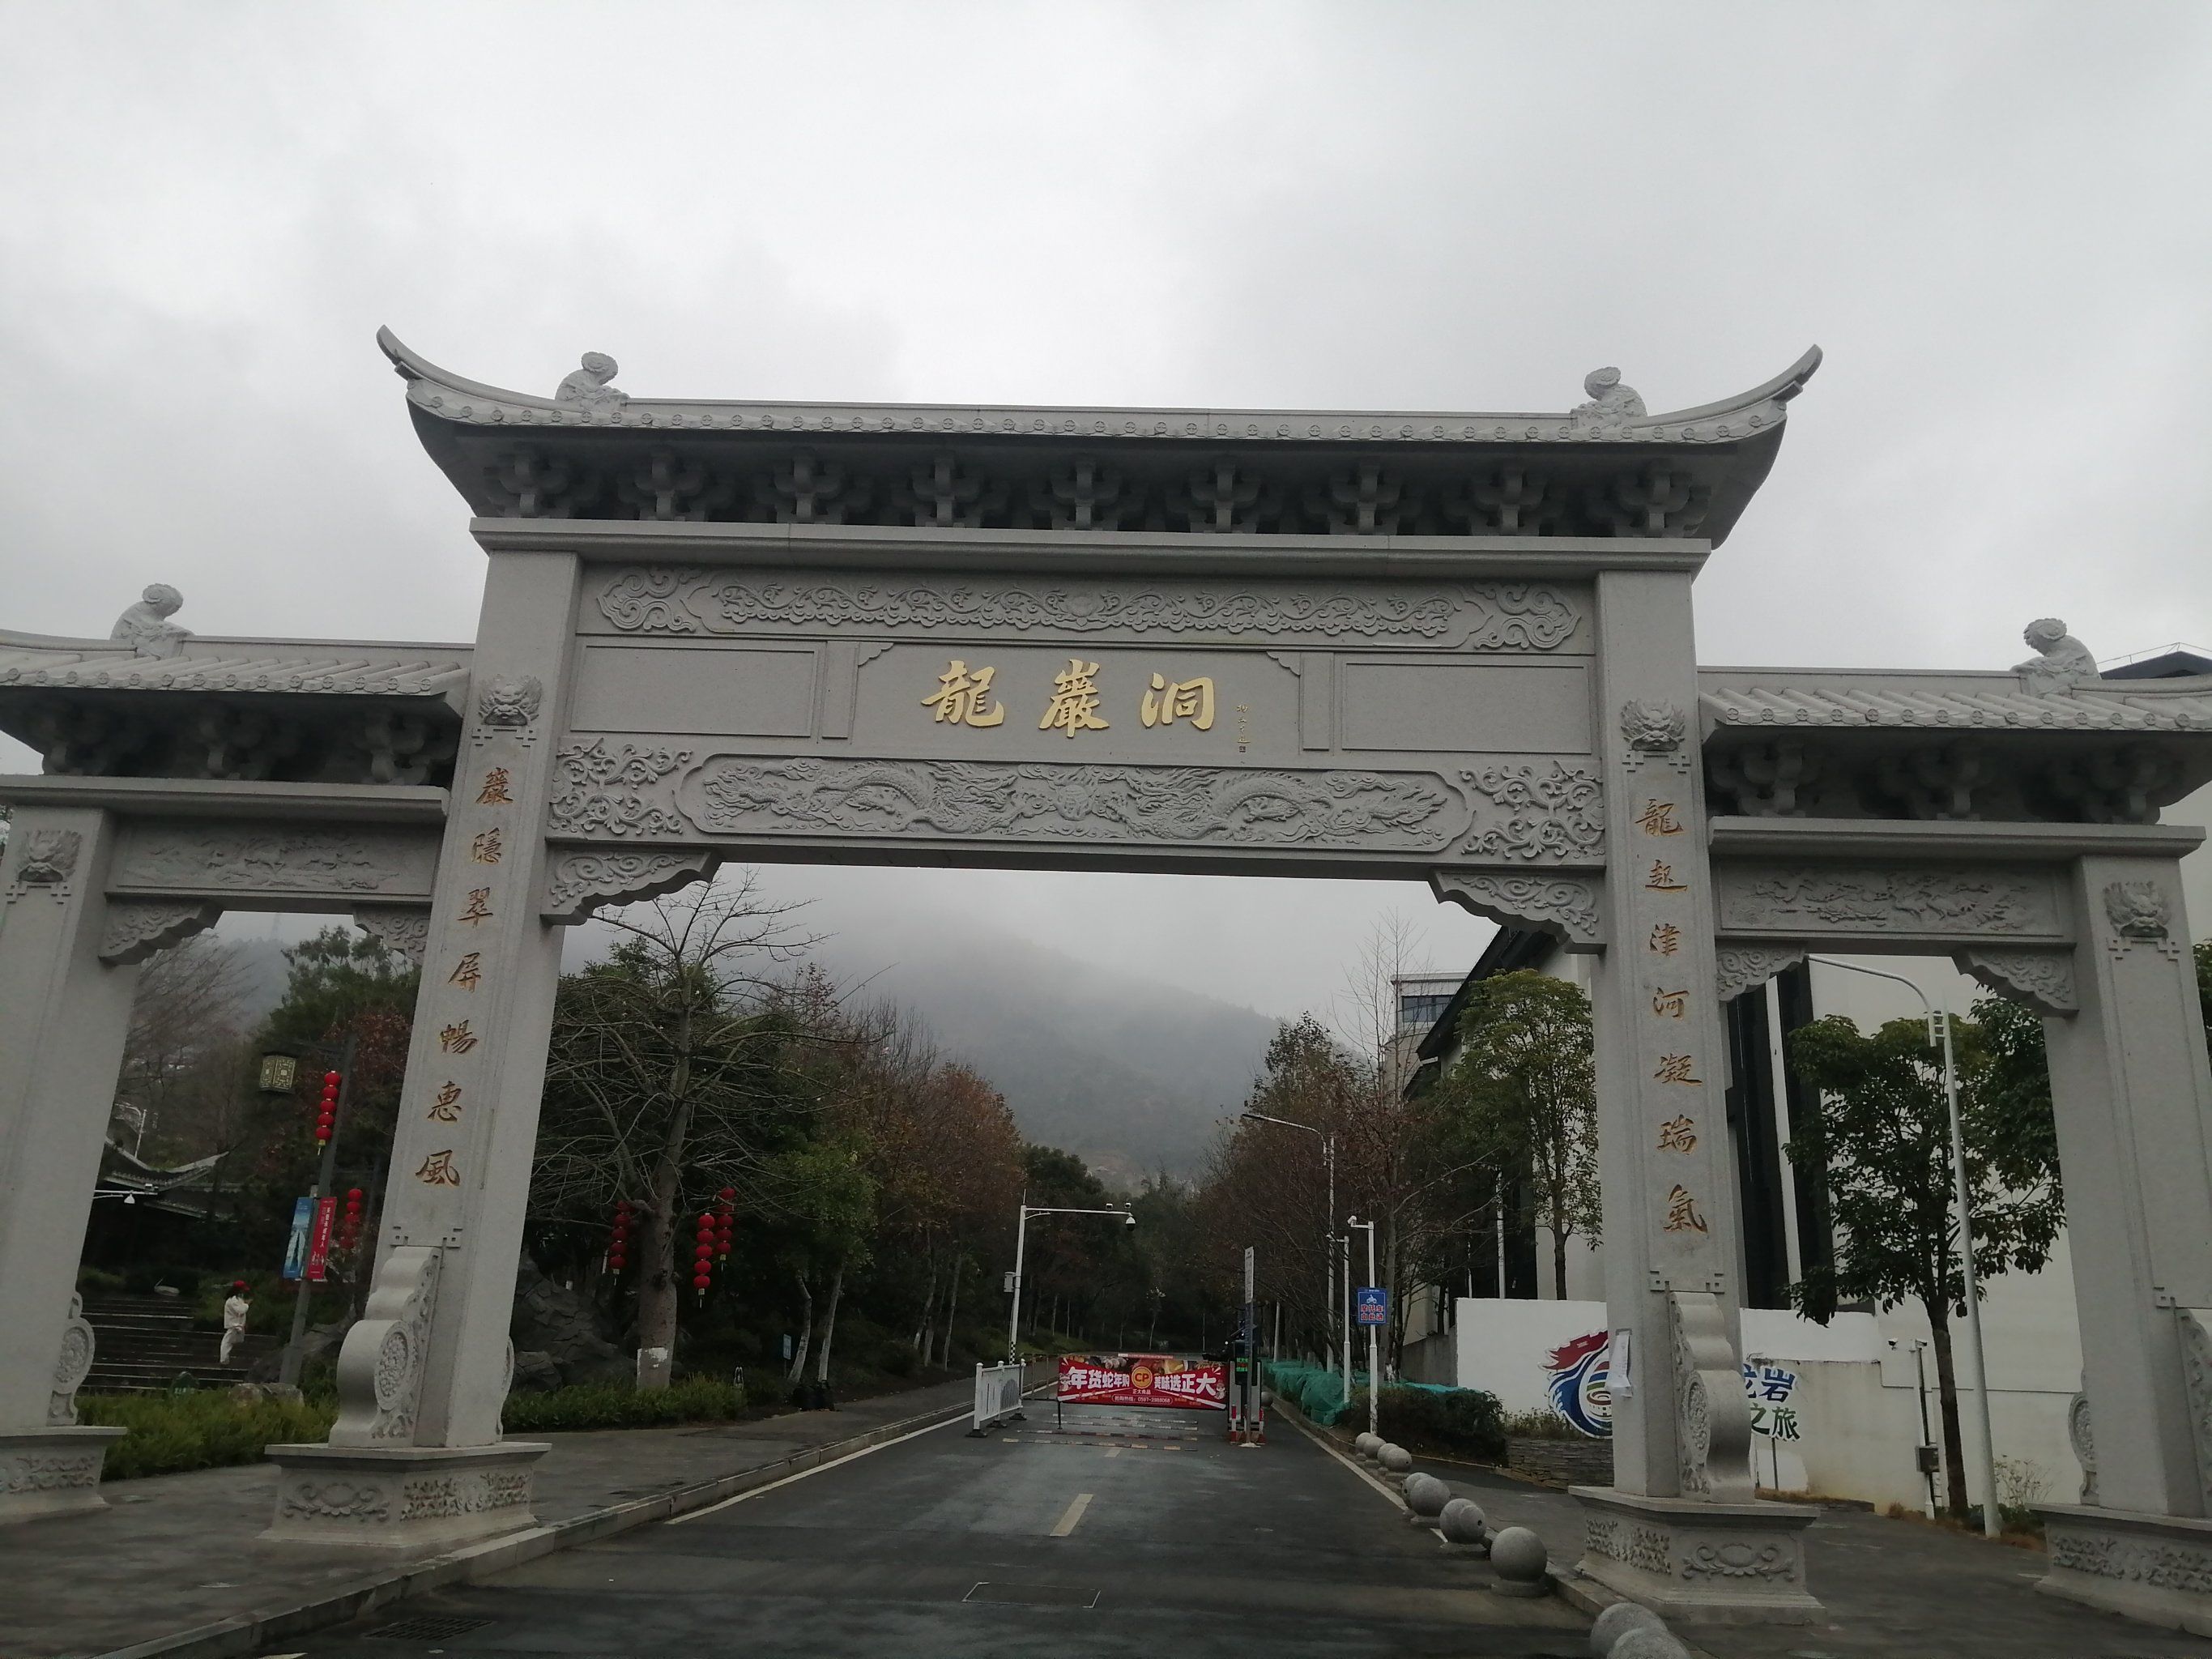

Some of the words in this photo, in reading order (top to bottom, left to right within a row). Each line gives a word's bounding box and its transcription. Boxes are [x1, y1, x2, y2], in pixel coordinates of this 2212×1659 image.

[1361, 1304, 1383, 1312] 摩托车
[1361, 1312, 1383, 1321] 由此进
[1068, 1366, 1130, 1390] 年货蛇年购
[1136, 1373, 1149, 1382] CP
[1154, 1372, 1217, 1396] 美味选正大
[1750, 1402, 1801, 1439] 之旅
